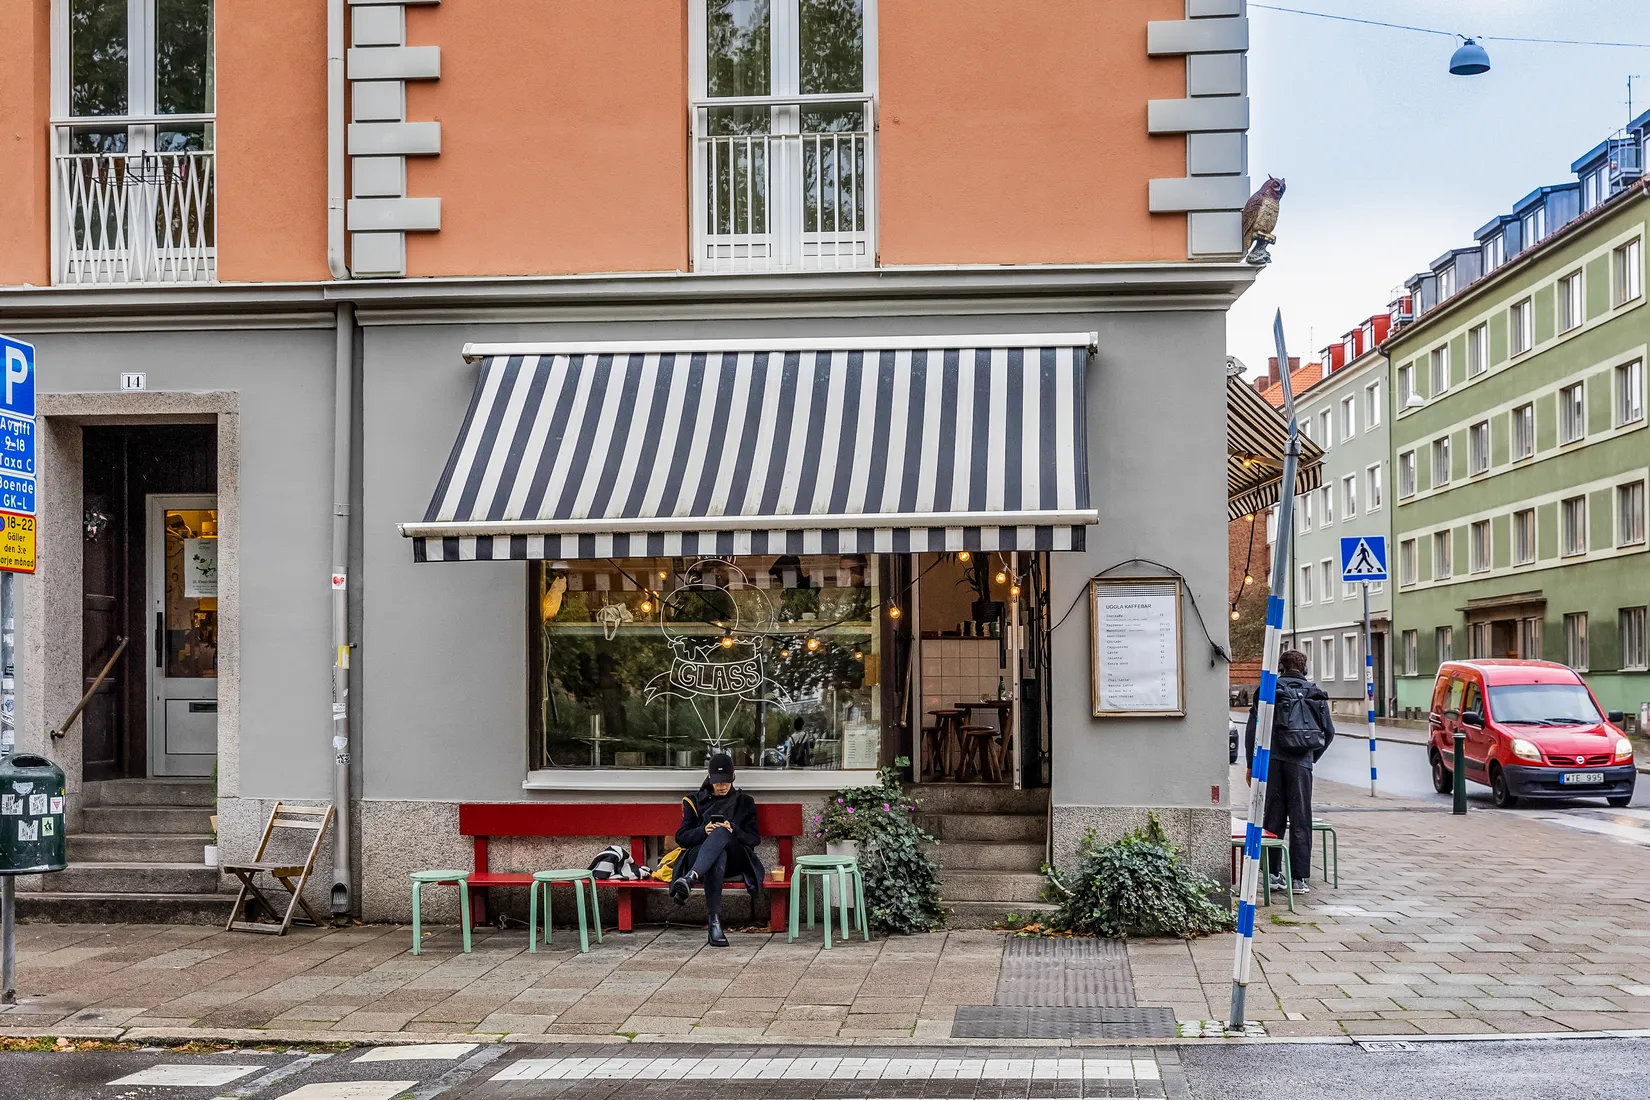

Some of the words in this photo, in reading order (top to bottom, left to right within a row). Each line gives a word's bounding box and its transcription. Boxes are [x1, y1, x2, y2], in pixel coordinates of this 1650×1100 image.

[5, 345, 28, 405] P
[126, 375, 142, 388] 14
[0, 416, 30, 436] Avgift
[5, 435, 25, 452] 9-18
[0, 452, 23, 469] Taxa
[26, 458, 32, 471] C
[3, 493, 27, 510] GK-L
[7, 515, 33, 532] 18-22
[7, 531, 26, 543] Gäller
[3, 543, 16, 554] den
[17, 544, 27, 555] 3:e
[0, 555, 13, 567] arje
[14, 557, 34, 568] månad
[678, 661, 761, 691] GLASS
[1565, 774, 1581, 782] WTE
[1586, 773, 1602, 782] 995
